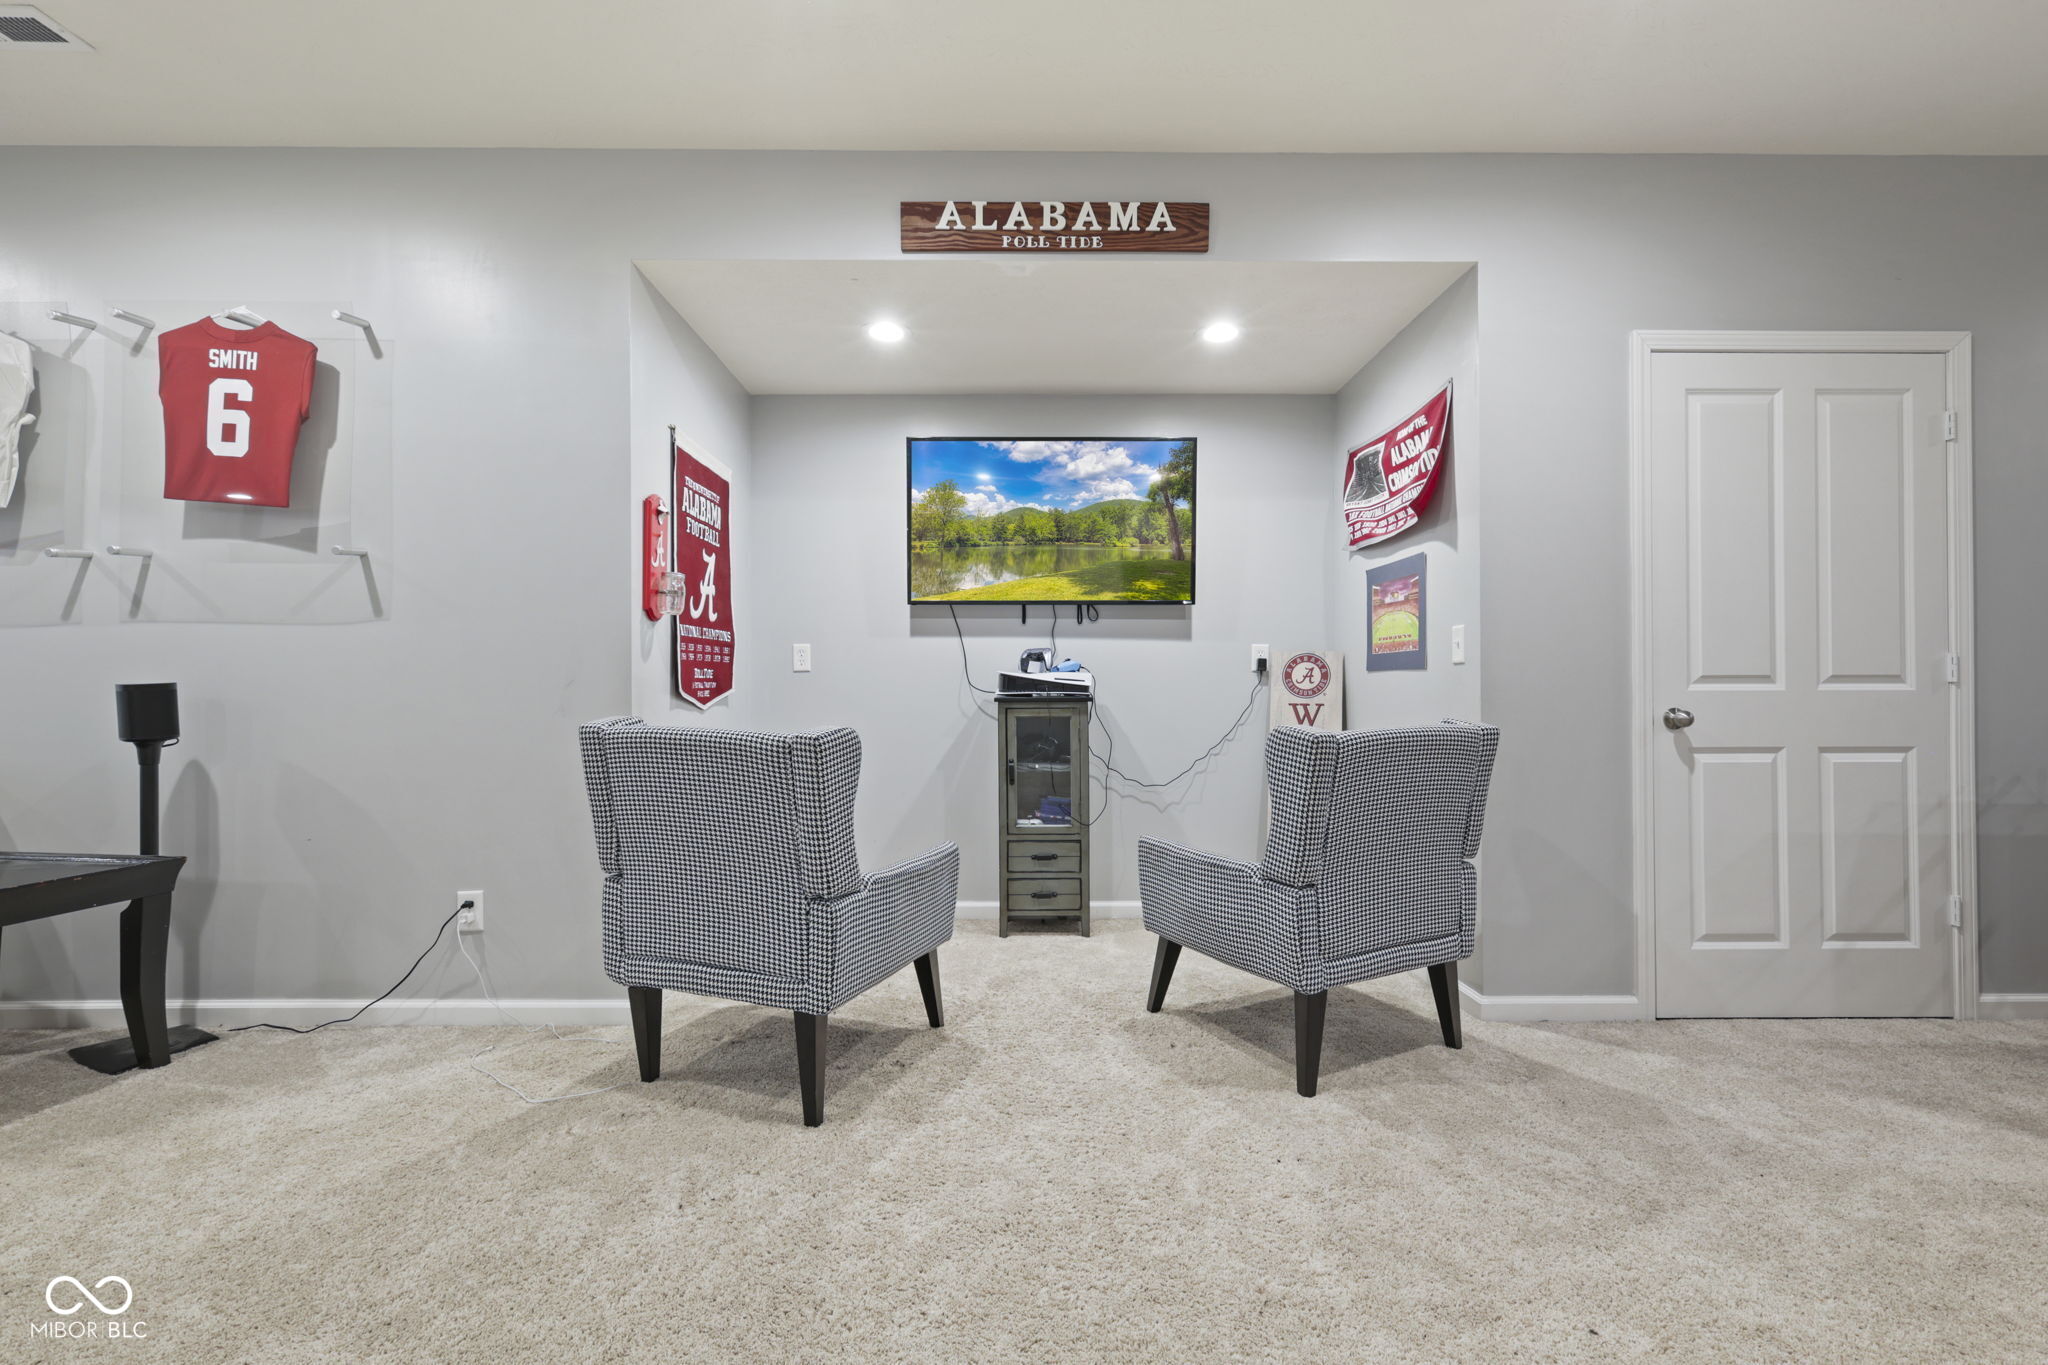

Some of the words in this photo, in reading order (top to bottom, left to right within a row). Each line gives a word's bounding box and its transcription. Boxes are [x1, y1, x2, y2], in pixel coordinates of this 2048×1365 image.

[935, 200, 1176, 232] ALABAMA
[1056, 235, 1104, 248] TIDE
[208, 348, 258, 371] SMITH
[206, 377, 253, 458] 6
[1391, 426, 1434, 467] ALABAM
[681, 486, 722, 531] ALABAMA
[686, 516, 721, 548] FOOTBALL
[650, 530, 666, 568] A
[689, 547, 718, 623] A
[679, 623, 702, 639] NATIONAL
[702, 627, 732, 642] CHAMPIONS
[1286, 655, 1328, 673] ALABAMA
[1295, 666, 1315, 684] A
[1285, 678, 1313, 696] CRIMSON
[1315, 678, 1328, 693] TIDE
[1288, 702, 1325, 727] W
